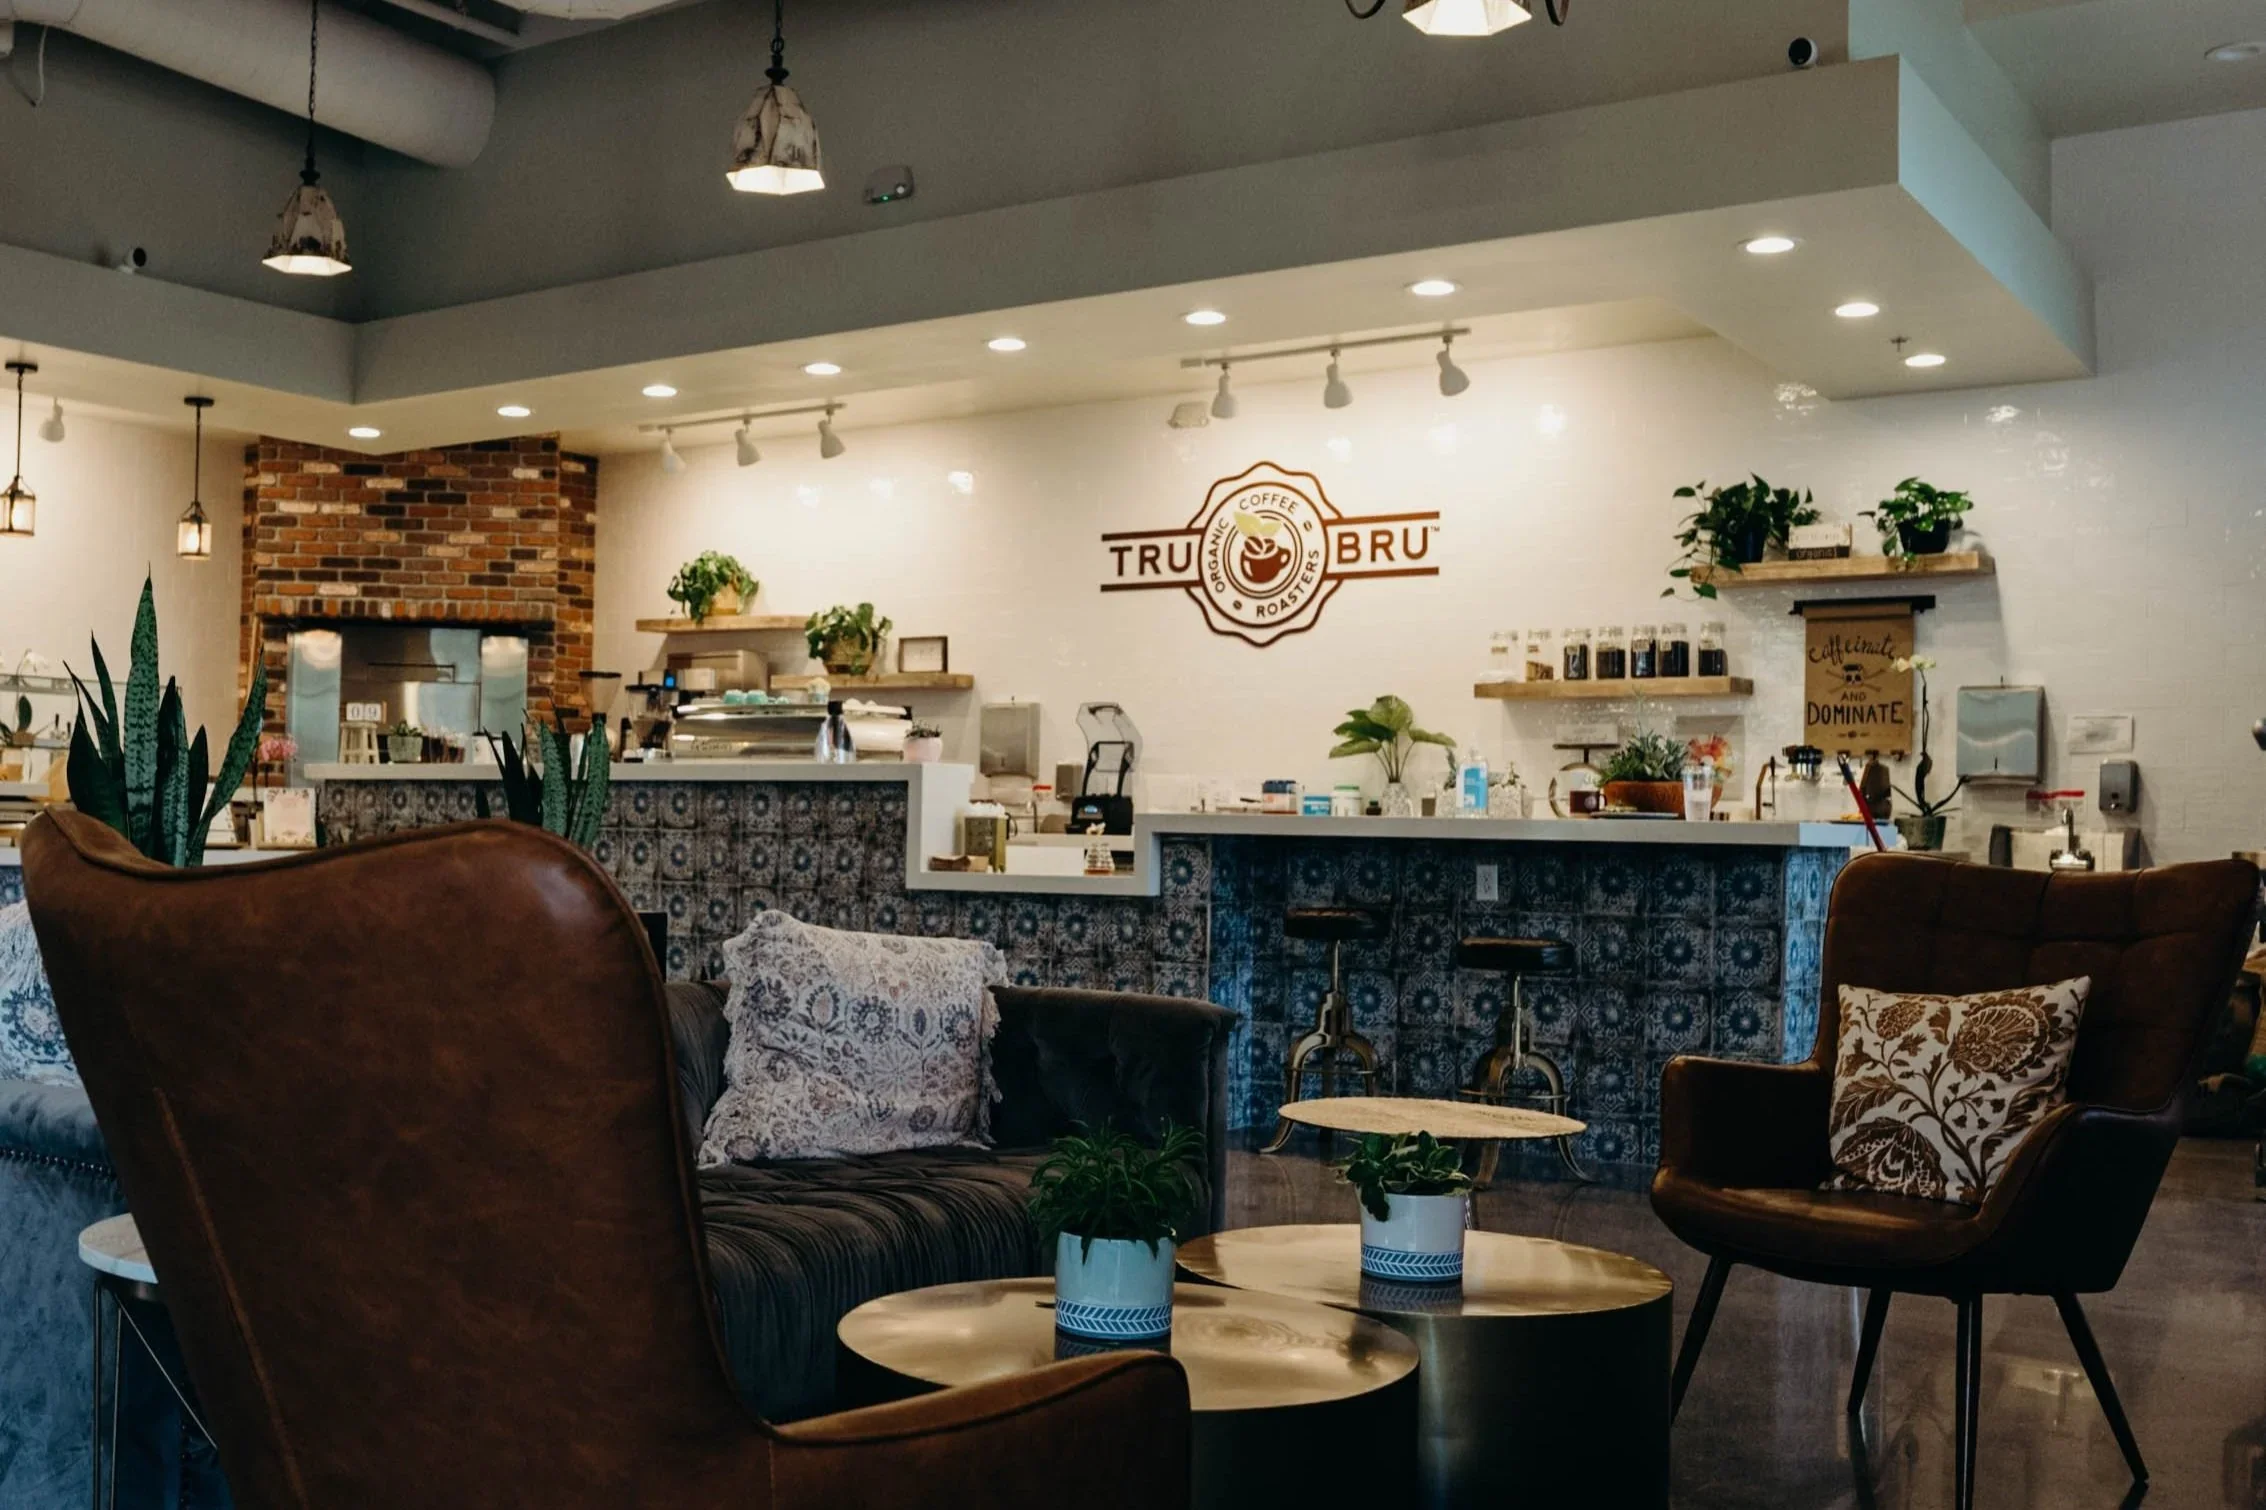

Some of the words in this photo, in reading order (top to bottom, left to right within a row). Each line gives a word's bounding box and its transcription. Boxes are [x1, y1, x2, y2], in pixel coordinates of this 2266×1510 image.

[1239, 493, 1299, 514] COFFEE
[1109, 542, 1191, 577] TRU
[1208, 518, 1229, 593] ORGANIC
[1256, 549, 1319, 617] ROASTERS
[1841, 691, 1867, 701] AND
[1807, 700, 1904, 726] DOMINATE
